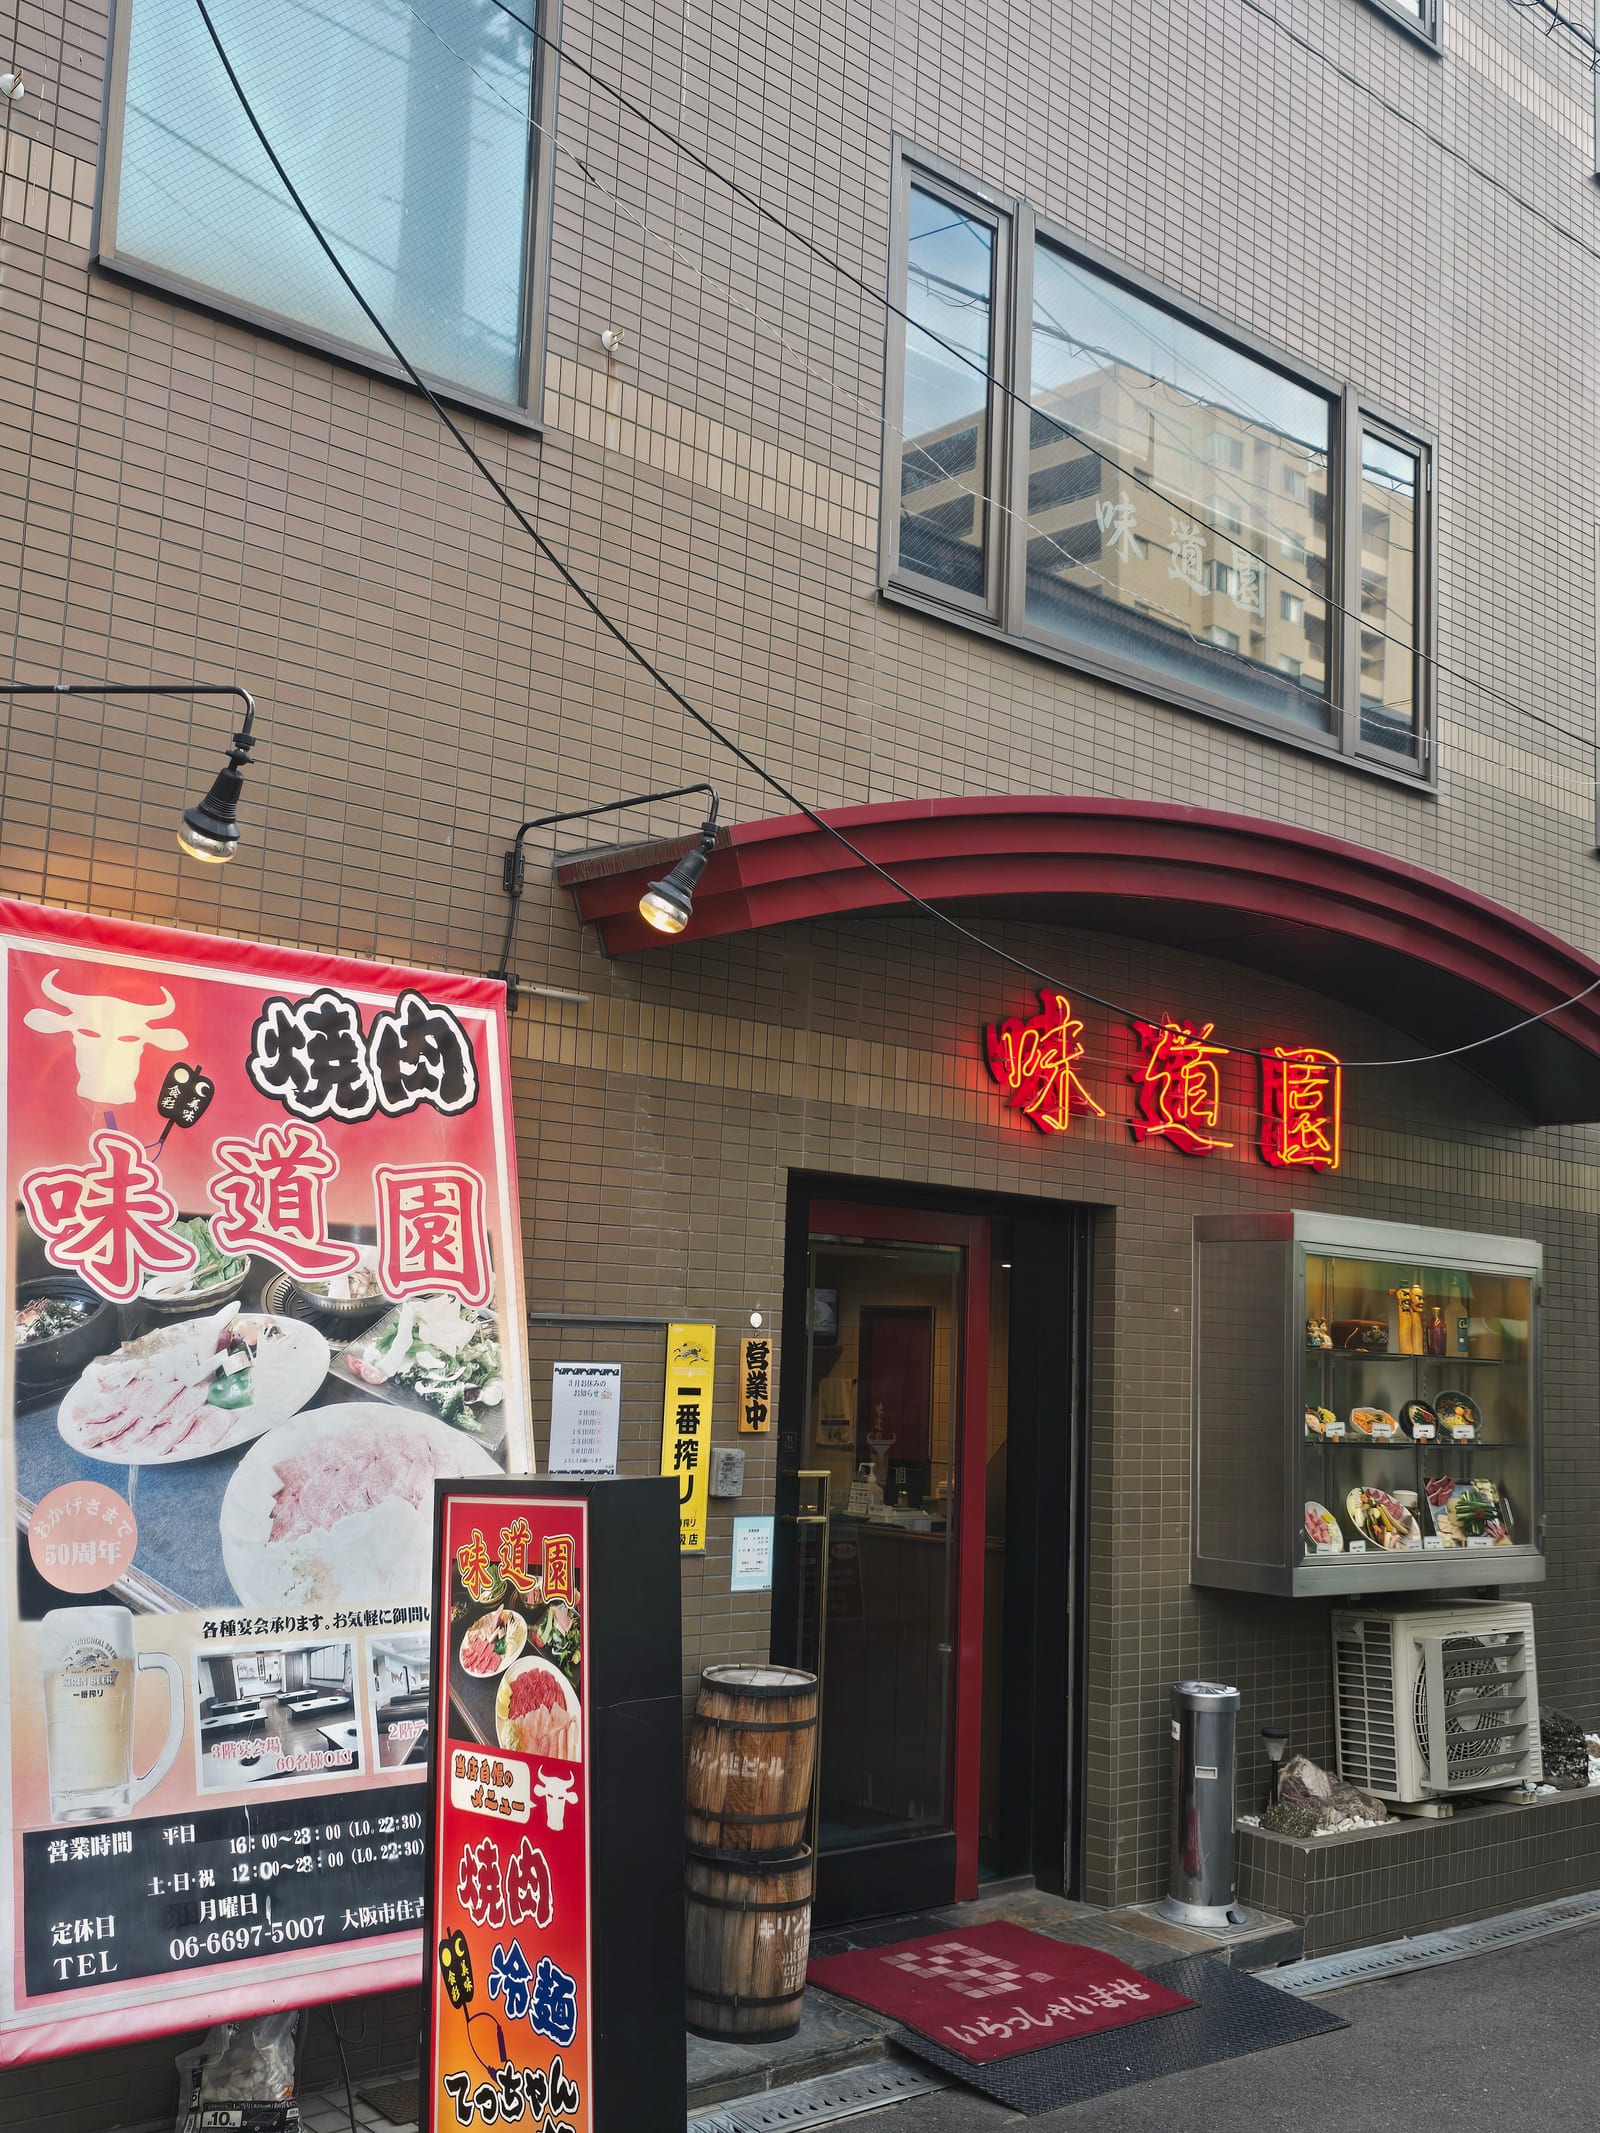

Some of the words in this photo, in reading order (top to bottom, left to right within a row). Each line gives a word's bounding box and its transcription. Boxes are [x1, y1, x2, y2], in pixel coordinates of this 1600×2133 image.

[1096, 491, 1265, 618] 味道園
[247, 988, 479, 1122] 焼肉
[987, 989, 1342, 1172] 味道園
[19, 1120, 493, 1306] 味道園
[745, 1340, 771, 1431] 営業中
[33, 1496, 133, 1540] おかげさまで
[44, 1539, 122, 1567] 50周年
[457, 1517, 576, 1609] 味道園
[211, 1738, 280, 1760] 3階宴会場
[276, 1750, 353, 1772] 60名様OK!
[455, 1754, 514, 1788] 当店自慢の
[471, 1785, 525, 1815] メニュー
[47, 1831, 133, 1864] 営業時間
[162, 1824, 196, 1846] 平日
[457, 1835, 554, 1929] 焼肉
[50, 1914, 116, 1947] 定休日
[200, 1893, 258, 1923] 月曜日
[53, 1950, 118, 1981] TEL
[169, 1915, 325, 1961] 06-6697-5007
[488, 1937, 578, 2047] 冷麺
[943, 1978, 1151, 2044] いらっしゃいませ
[443, 2055, 580, 2126] てっちゃん
